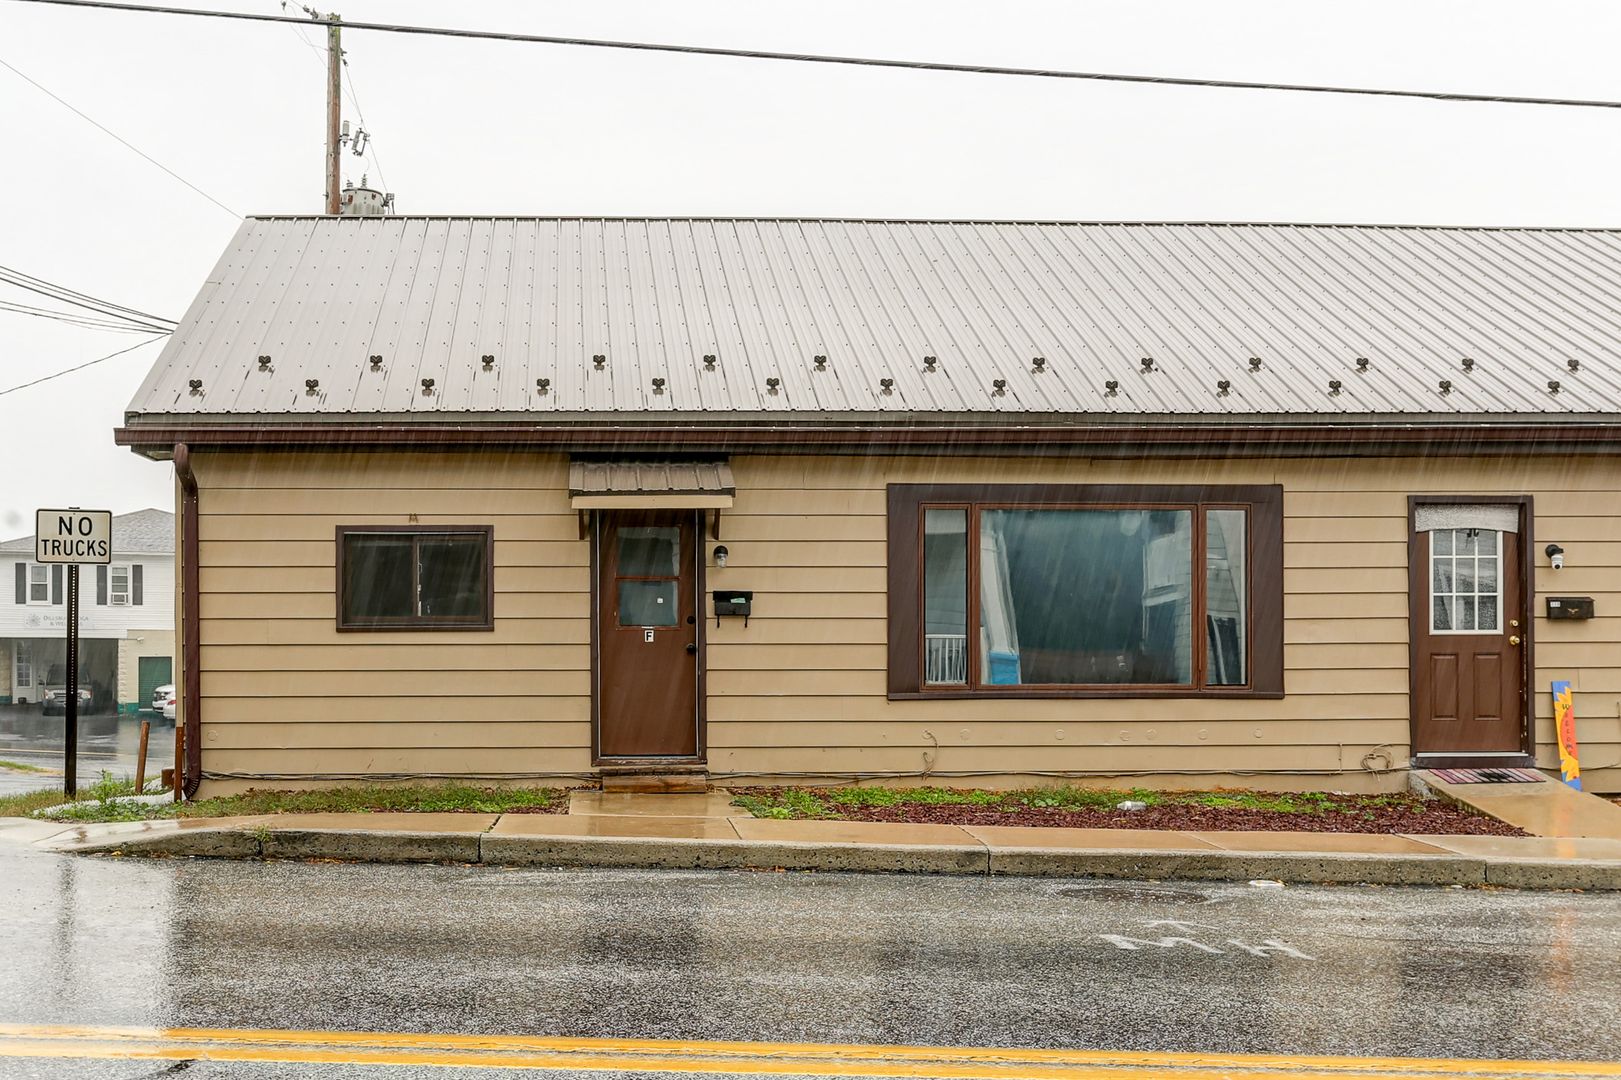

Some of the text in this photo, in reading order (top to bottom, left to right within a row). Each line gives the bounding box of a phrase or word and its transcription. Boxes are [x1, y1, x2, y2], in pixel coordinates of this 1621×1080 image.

[59, 516, 92, 536] NO
[41, 539, 107, 556] TRUCKS
[646, 631, 653, 641] F
